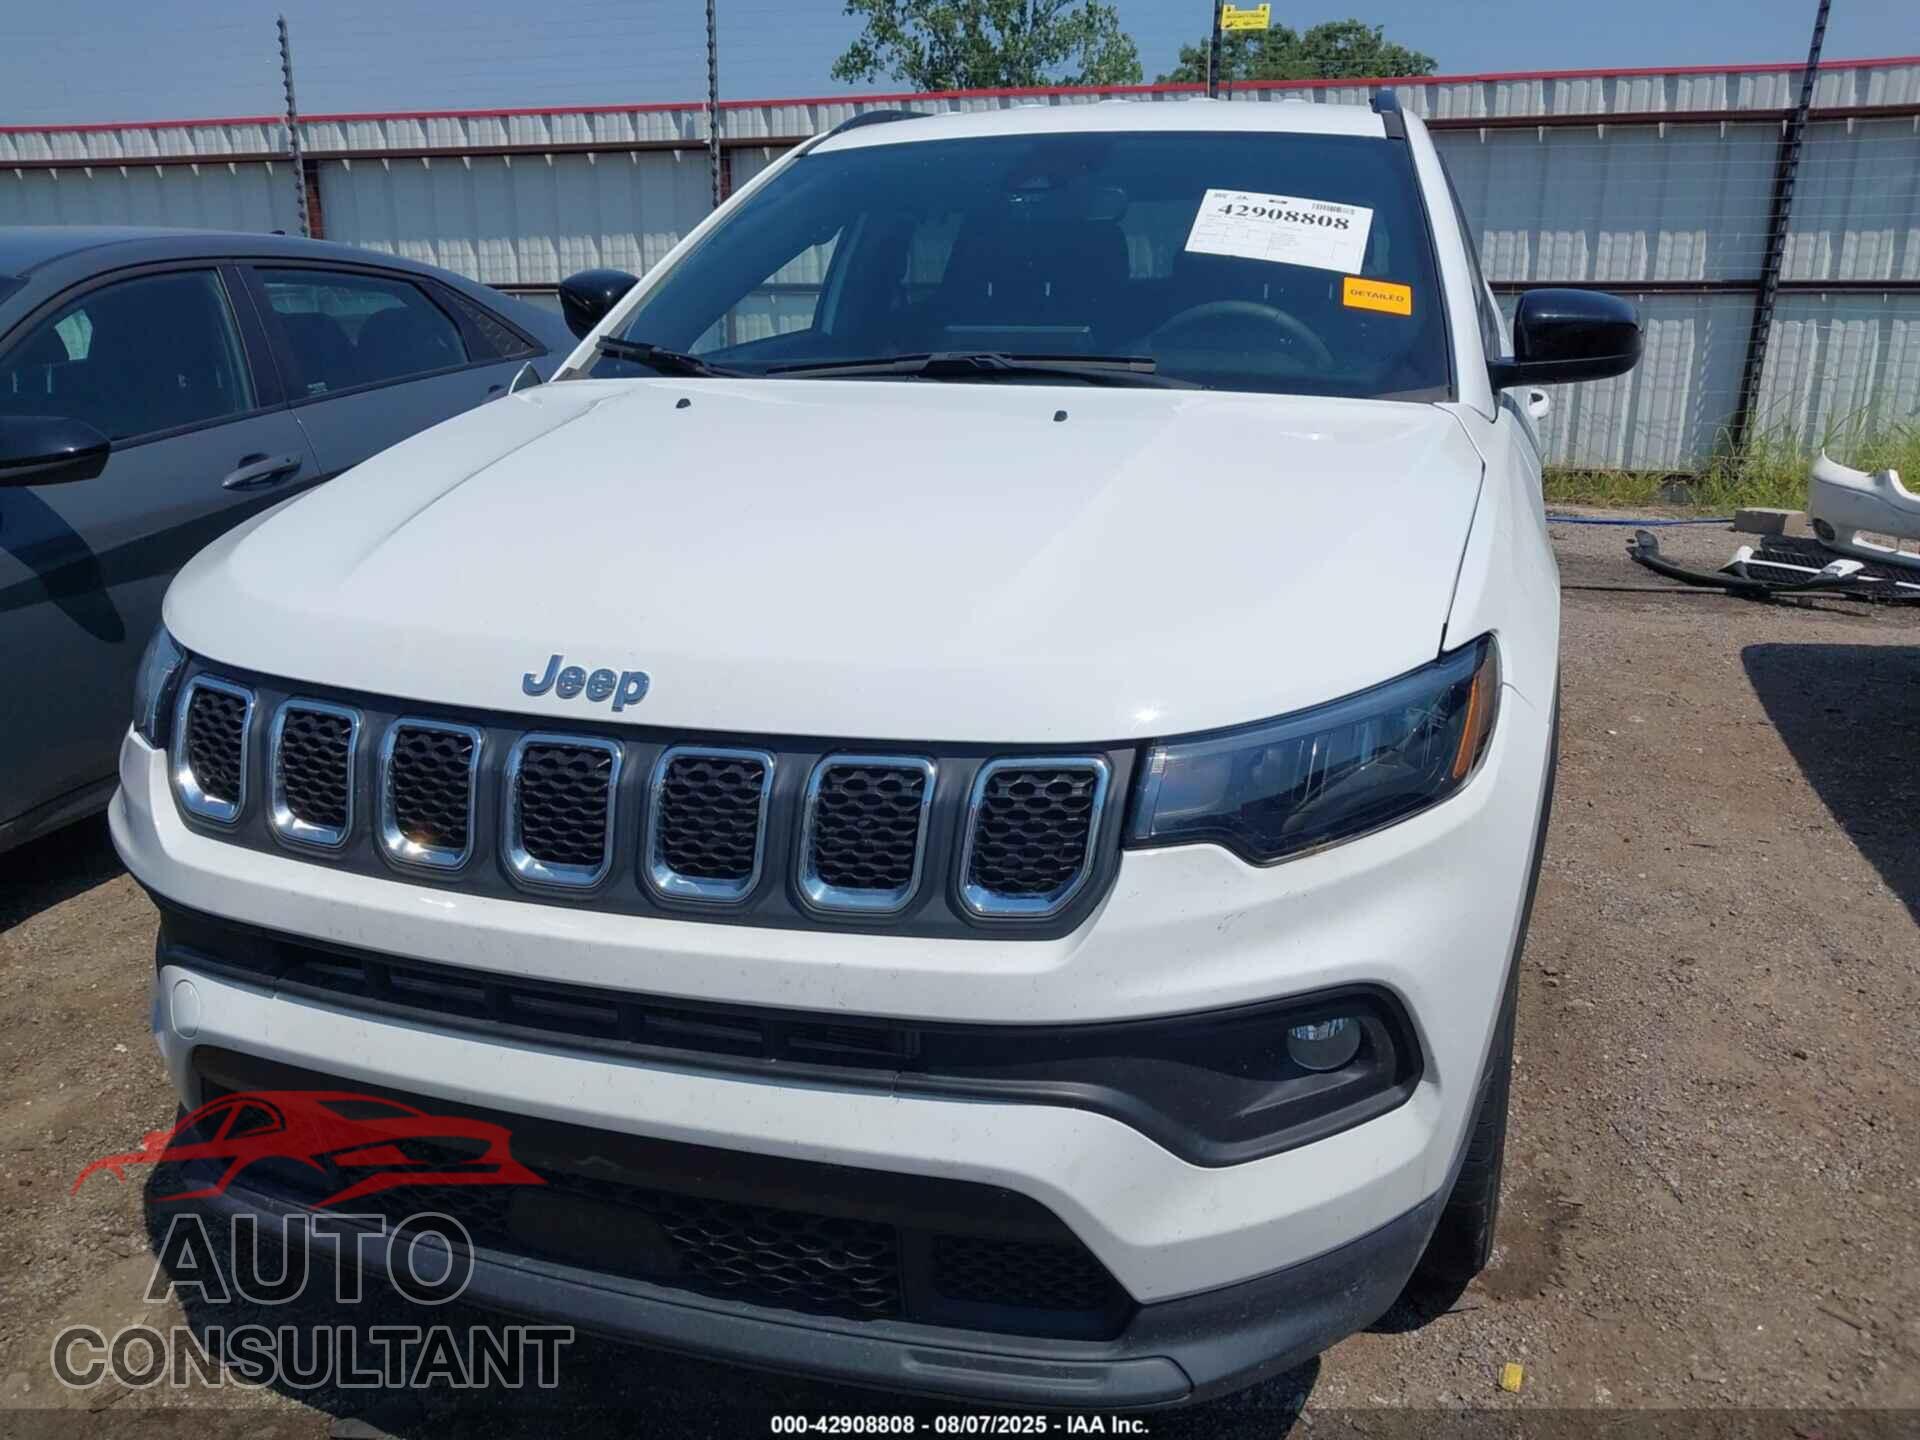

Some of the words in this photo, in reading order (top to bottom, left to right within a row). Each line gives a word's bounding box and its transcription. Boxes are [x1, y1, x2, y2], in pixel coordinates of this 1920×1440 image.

[1216, 203, 1351, 230] 42908808
[1350, 288, 1405, 303] DETAILED
[522, 654, 650, 712] Jeep
